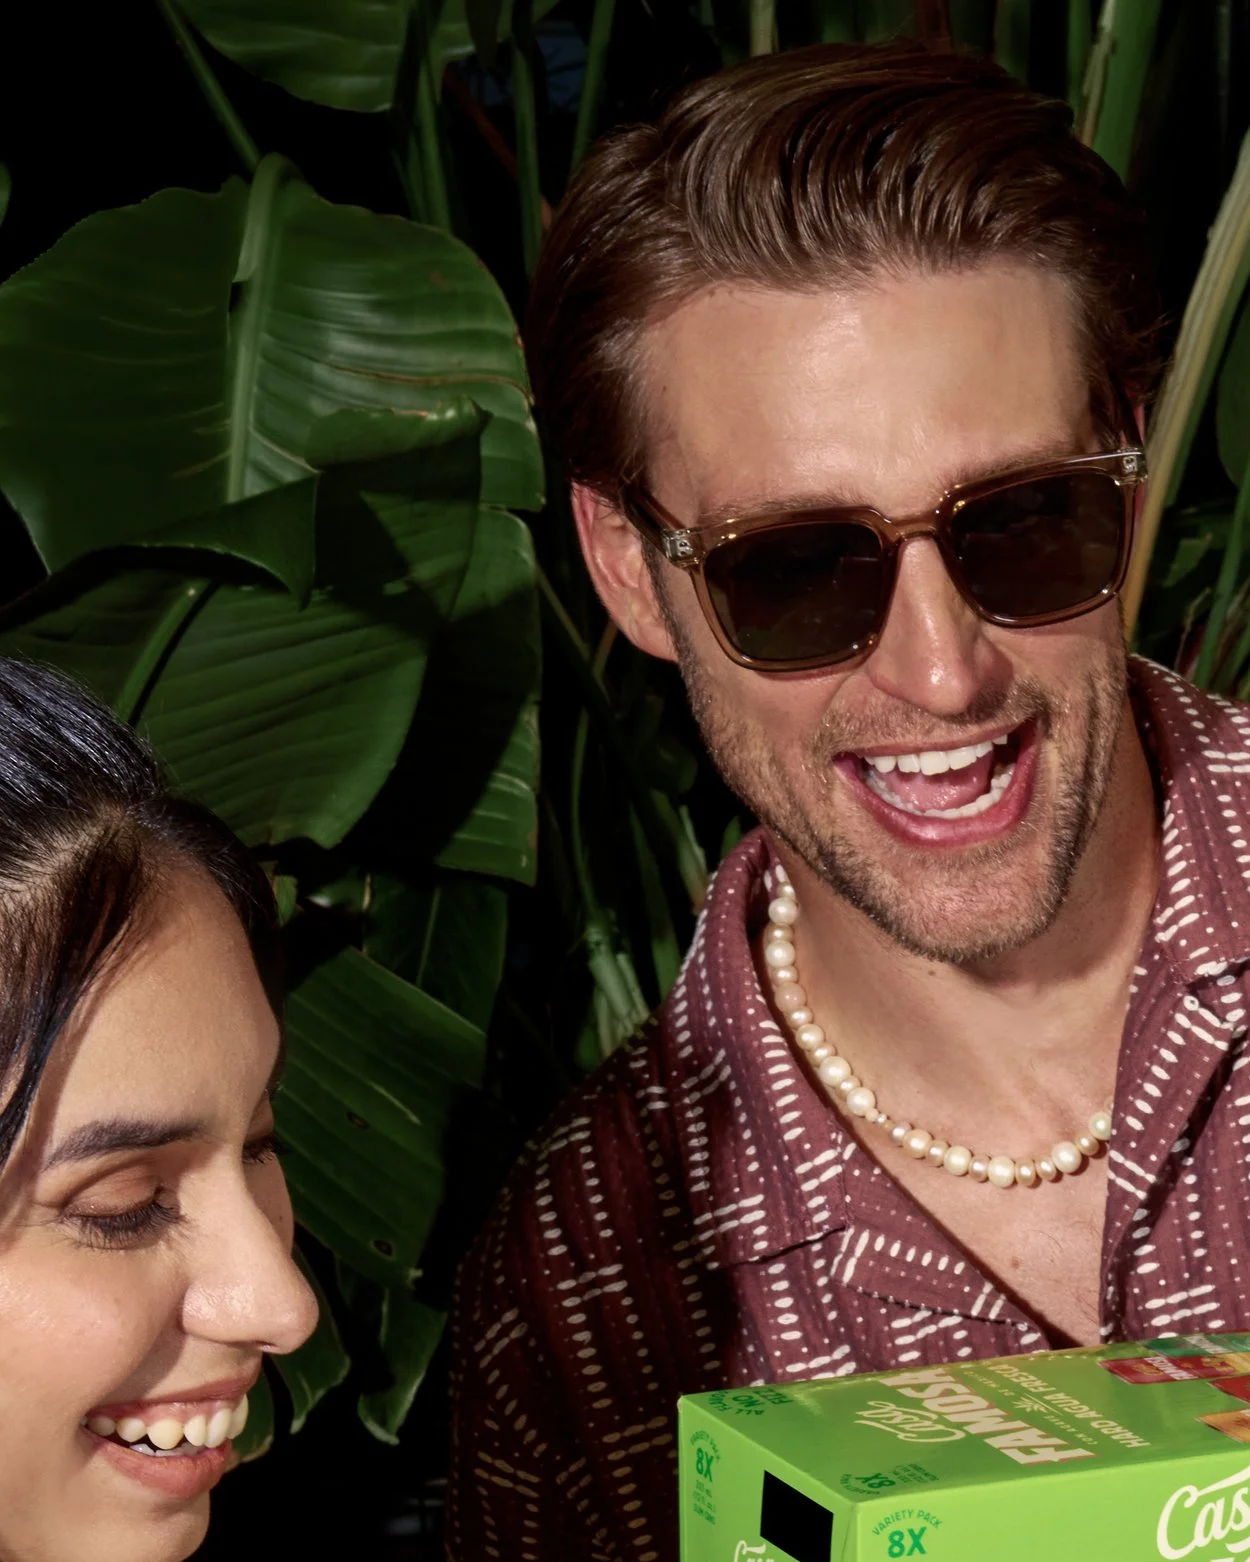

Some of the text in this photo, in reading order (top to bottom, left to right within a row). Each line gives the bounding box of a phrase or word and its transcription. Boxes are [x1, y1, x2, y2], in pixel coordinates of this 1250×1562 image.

[853, 1400, 965, 1442] Casa
[879, 1367, 1097, 1465] FAMOSA
[1043, 1391, 1102, 1420] AGUA
[1091, 1420, 1151, 1448] HARD
[695, 1447, 713, 1483] 8X
[872, 1509, 942, 1536] VARIETY PACK
[887, 1526, 927, 1558] 8X
